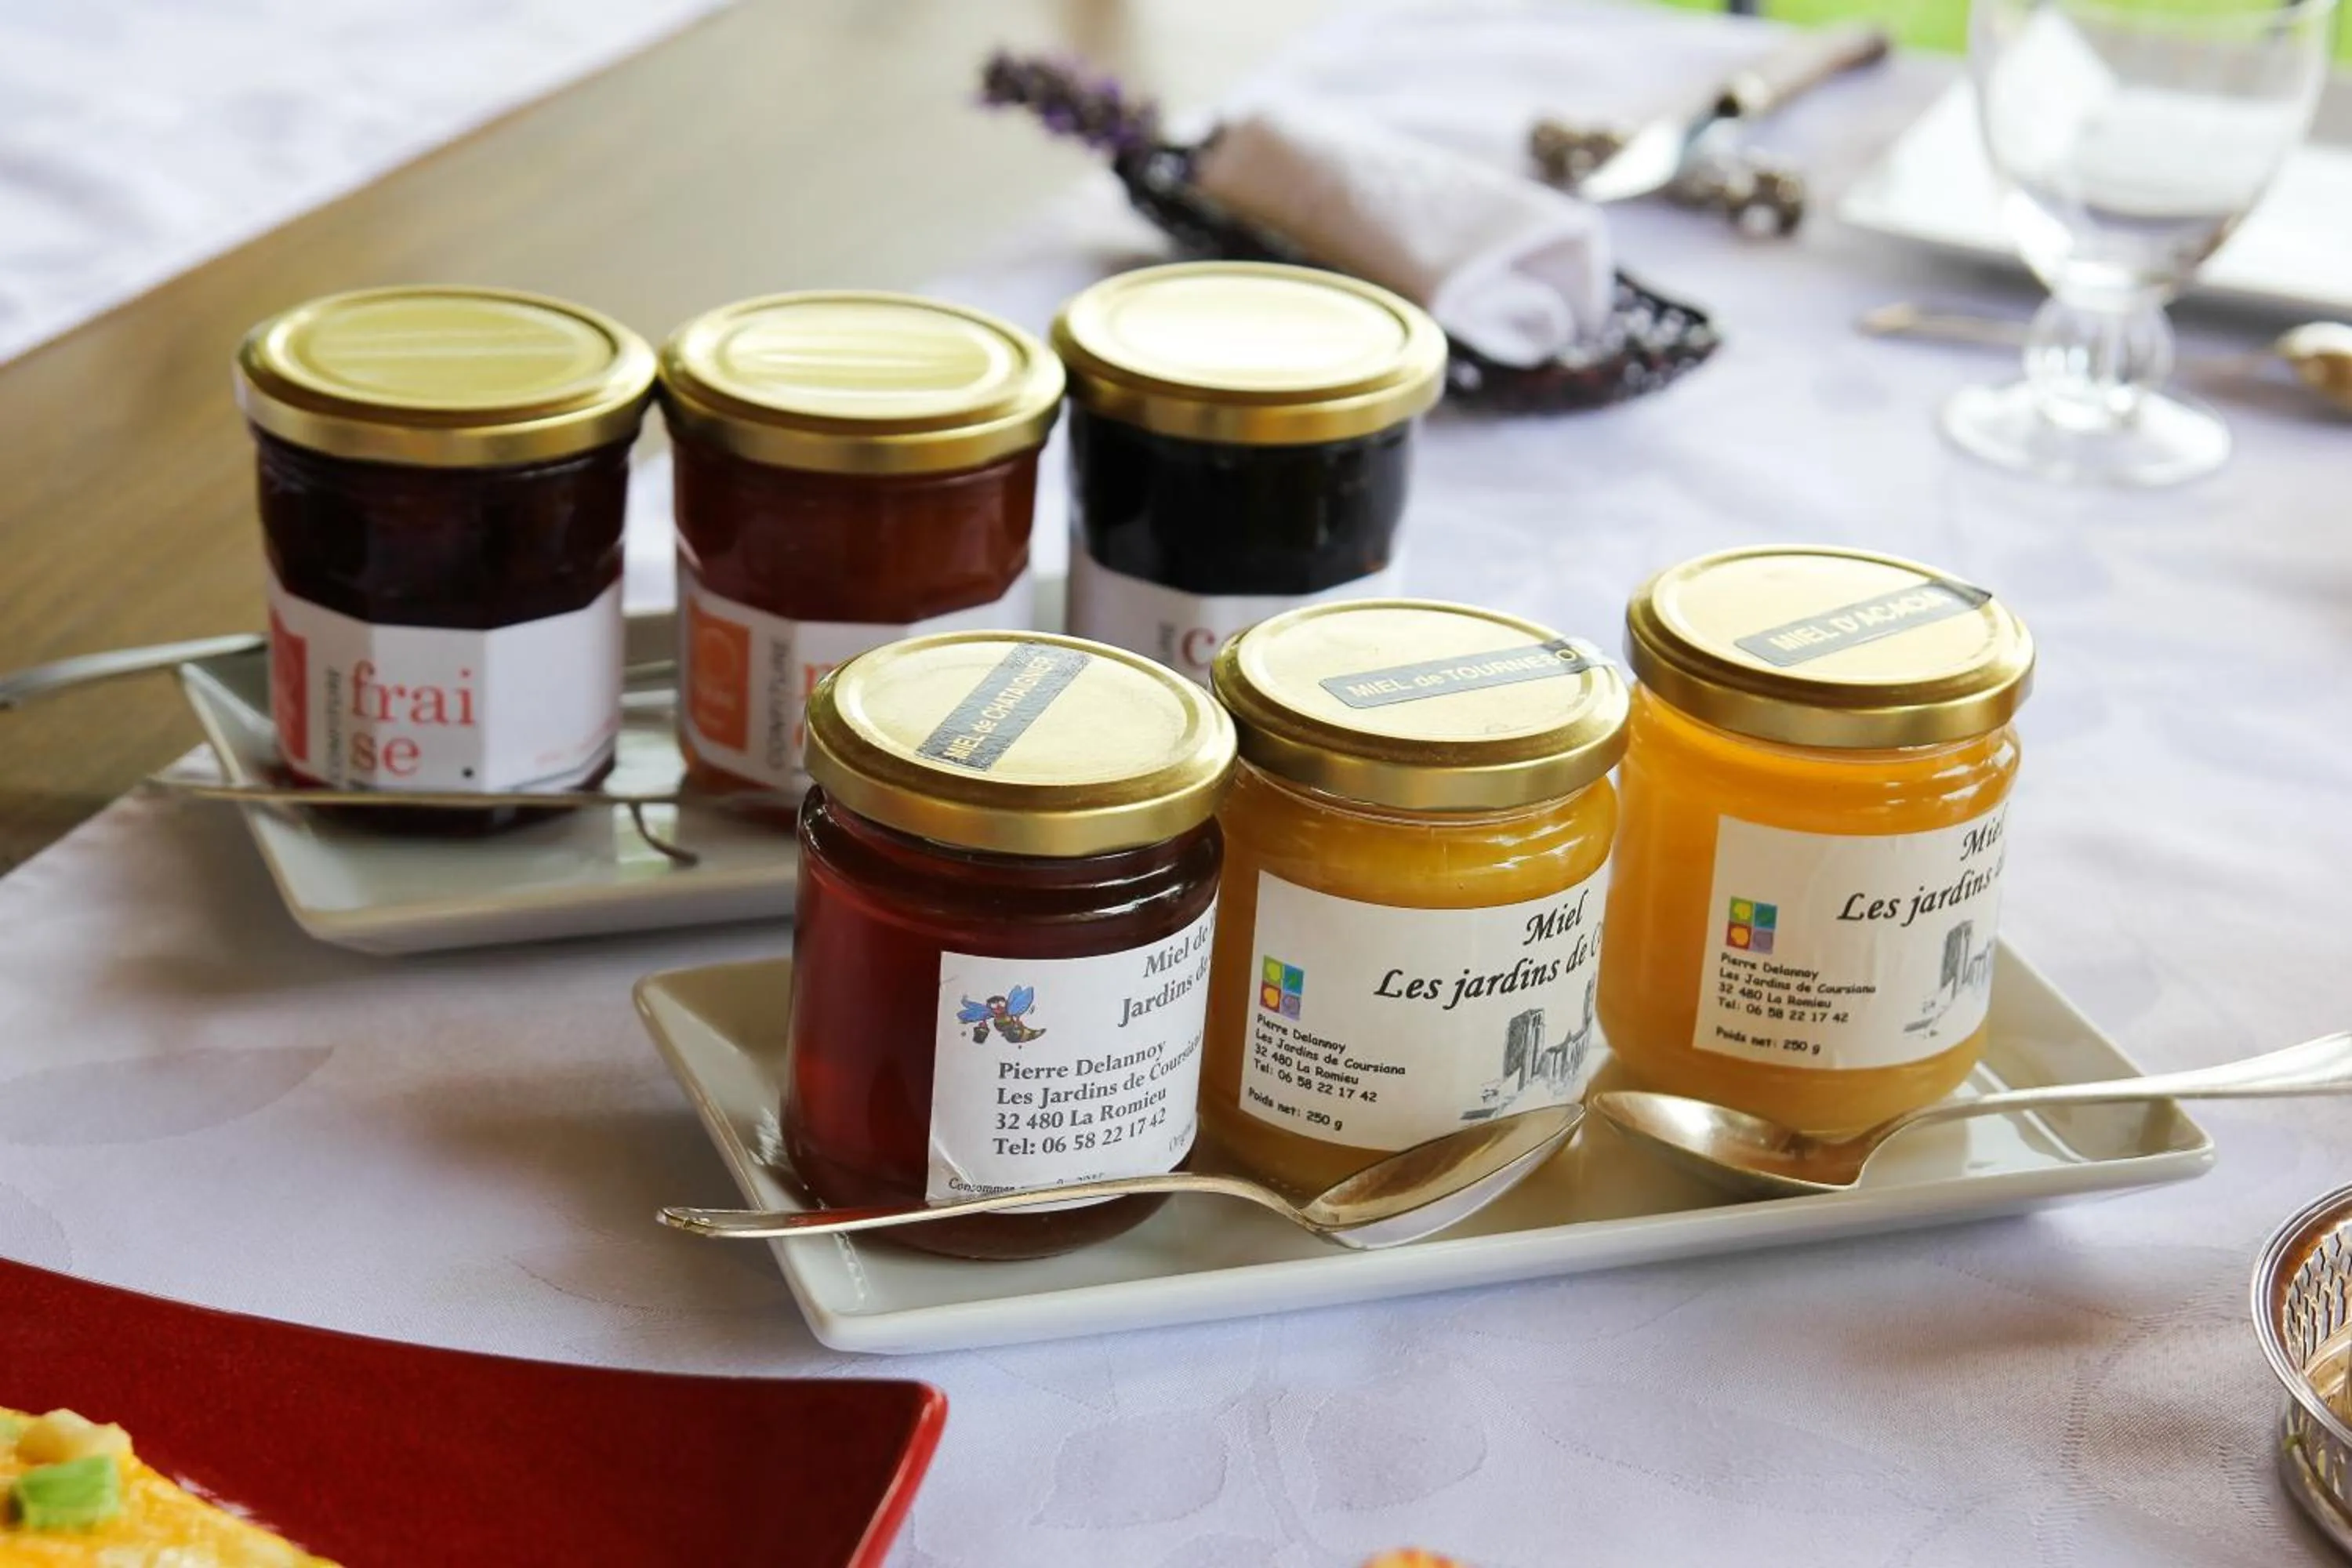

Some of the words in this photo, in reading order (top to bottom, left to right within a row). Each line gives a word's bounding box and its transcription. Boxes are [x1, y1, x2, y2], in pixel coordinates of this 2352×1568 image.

[1769, 625, 1840, 652] MIEL
[350, 659, 475, 726] frai
[1346, 677, 1413, 698] MIEL
[1414, 672, 1445, 689] de
[1445, 648, 1579, 682] TOURNESO
[350, 731, 420, 776] se
[944, 733, 985, 759] MIEL
[1523, 888, 1588, 946] Miel
[1836, 892, 1901, 921] Les
[1900, 867, 1992, 927] jardins
[1143, 937, 1189, 978] Miel
[1193, 926, 1208, 950] de
[1373, 968, 1443, 1000] Les
[1443, 957, 1561, 1011] jardins
[1566, 934, 1588, 975] de
[1720, 952, 1757, 971] Pierre
[1763, 962, 1820, 982] Delannoy
[1117, 975, 1193, 1028] Jardins
[1718, 982, 1733, 995] 32
[1738, 987, 1762, 1001] 480
[1767, 993, 1782, 1004] La
[1787, 996, 1831, 1009] Romieu
[1719, 967, 1739, 982] Les
[1744, 974, 1791, 991] Jardins
[1796, 982, 1811, 994] de
[1817, 983, 1877, 996] Coursiana
[1718, 996, 1740, 1011] Tel:
[1746, 1004, 1762, 1017] 06
[1768, 1008, 1784, 1020] 58
[1789, 1011, 1806, 1022] 22
[1811, 1012, 1827, 1022] 17
[1832, 1012, 1849, 1024] 42
[1255, 1028, 1273, 1044] Les
[1276, 1037, 1319, 1061] Jardins
[1323, 1053, 1339, 1065] de
[1344, 1058, 1406, 1075] Coursiana
[1257, 1013, 1288, 1036] Pierre
[1293, 1029, 1346, 1054] Delannoy
[1715, 1025, 1747, 1044] Poids
[1751, 1036, 1777, 1049] net:
[1783, 1039, 1808, 1052] 250
[1812, 1044, 1821, 1055] g
[998, 1062, 1069, 1080] Pierre
[1075, 1040, 1167, 1077] Delannoy
[1254, 1043, 1268, 1058] 32
[1272, 1051, 1293, 1067] 480
[1296, 1061, 1310, 1074] La
[1315, 1065, 1359, 1085] Romieu
[1254, 1058, 1273, 1075] Tel:
[1278, 1069, 1293, 1083] 06
[1297, 1076, 1312, 1090] 58
[1317, 1082, 1333, 1095] 22
[1338, 1087, 1356, 1099] 17
[1359, 1091, 1377, 1103] 42
[995, 1112, 1020, 1130] 32
[1026, 1112, 1064, 1130] 480
[1069, 1109, 1094, 1127] La
[1099, 1087, 1167, 1122] Romieu
[996, 1087, 1033, 1105] Les
[1038, 1079, 1118, 1109] Jardins
[1123, 1073, 1145, 1091] de
[1248, 1087, 1274, 1108] Poids
[1278, 1102, 1301, 1117] net:
[1306, 1110, 1330, 1127] 250
[1334, 1119, 1343, 1131] g
[992, 1138, 1036, 1156] Tel:
[1042, 1136, 1067, 1154] 06
[1073, 1133, 1096, 1151] 58
[1102, 1126, 1123, 1145] 22
[1128, 1118, 1146, 1138] 17
[1149, 1108, 1167, 1128] 42
